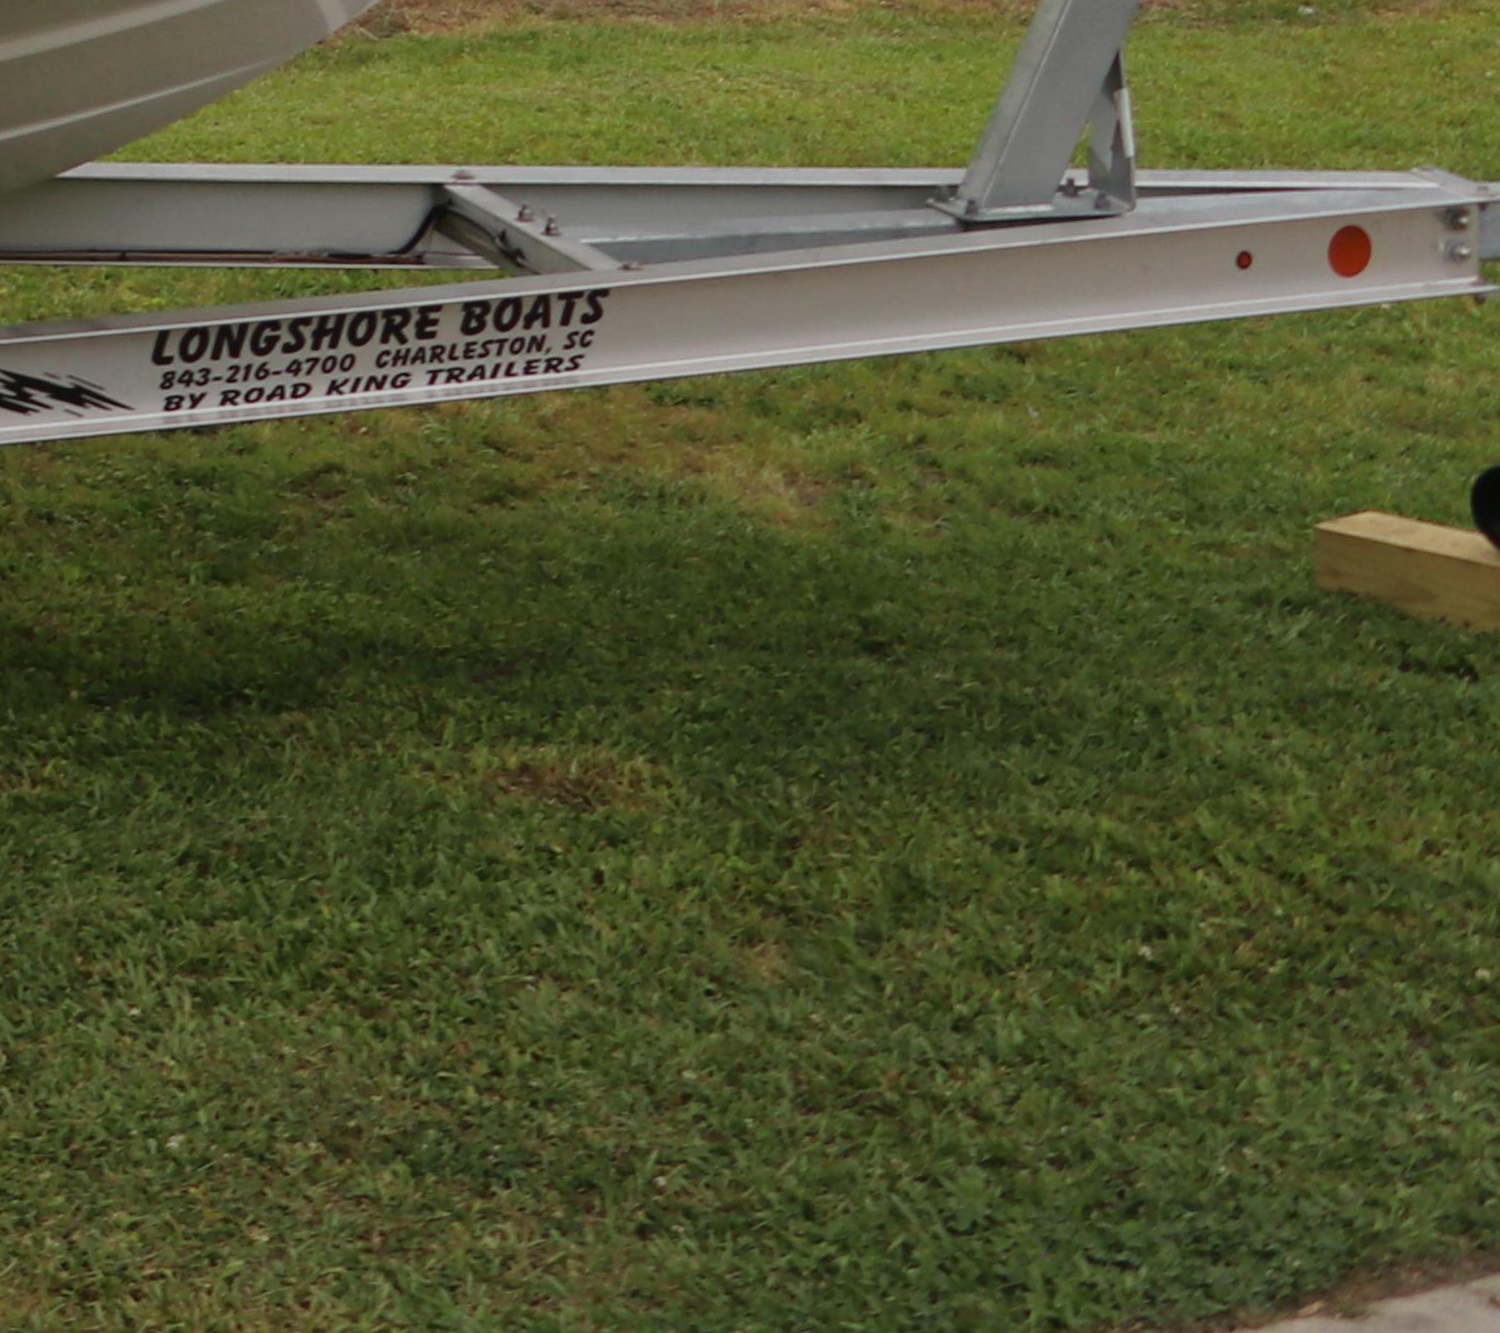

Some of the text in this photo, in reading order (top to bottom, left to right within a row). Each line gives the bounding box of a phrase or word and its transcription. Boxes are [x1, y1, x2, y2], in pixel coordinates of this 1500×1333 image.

[151, 288, 610, 366] LONGSHORE BOATS
[159, 329, 595, 390] 843-216-4700 CHARLESTON, SC
[163, 354, 586, 411] BY ROAD KING TRAILERS
